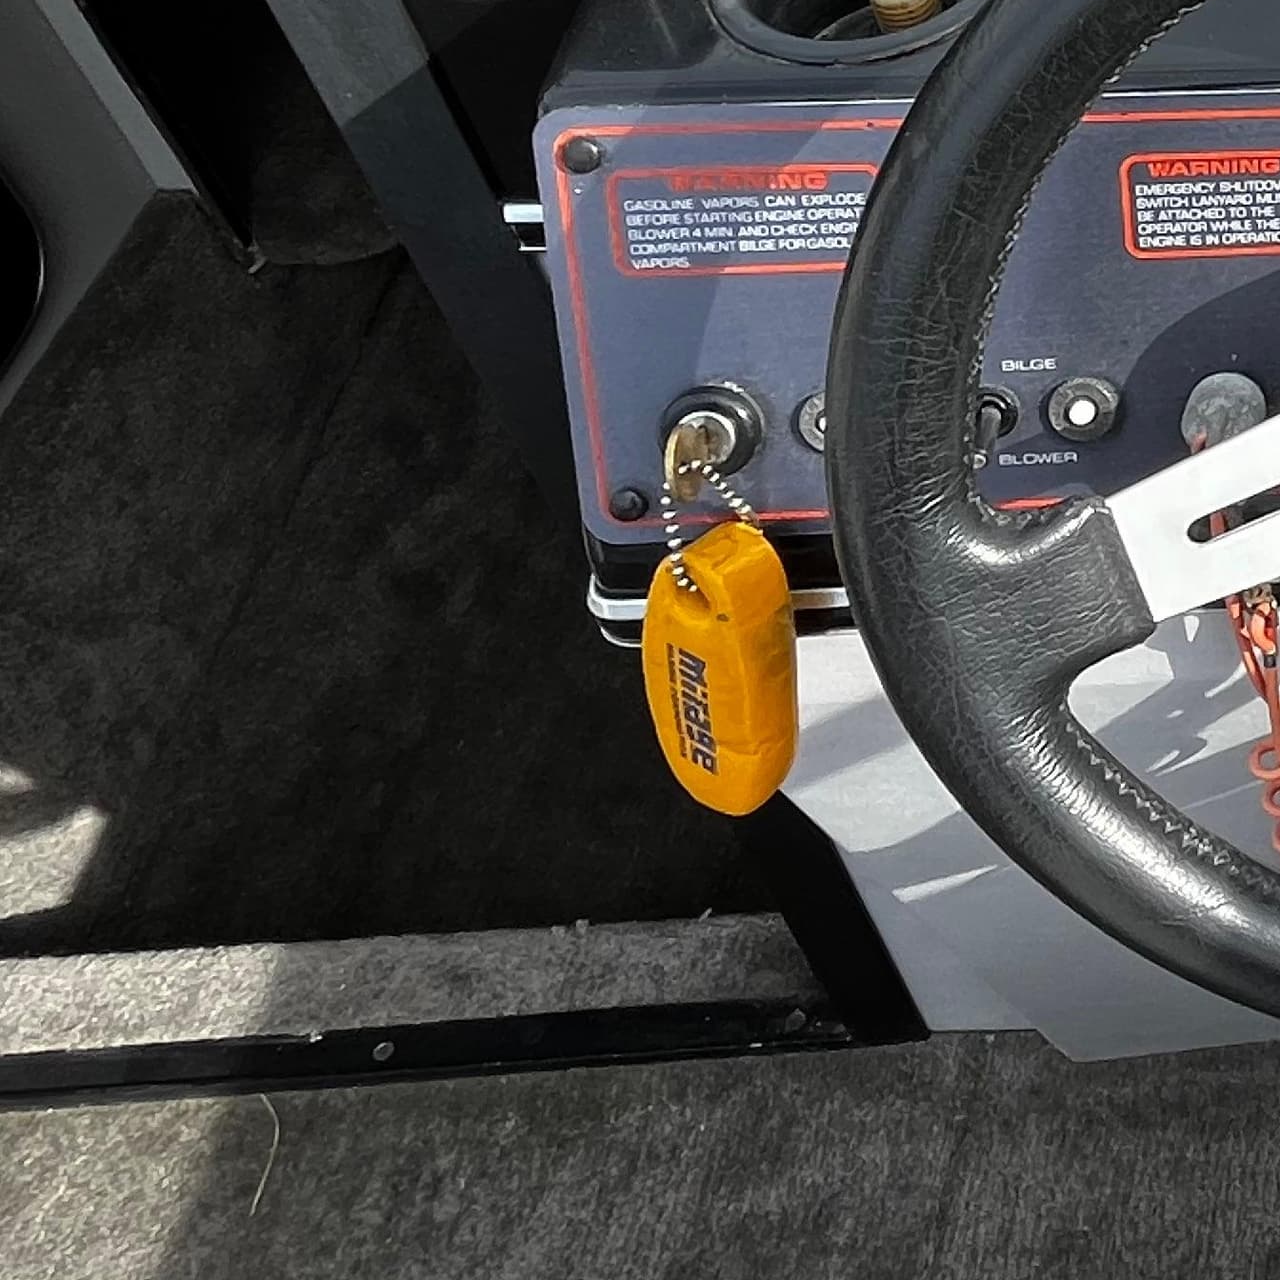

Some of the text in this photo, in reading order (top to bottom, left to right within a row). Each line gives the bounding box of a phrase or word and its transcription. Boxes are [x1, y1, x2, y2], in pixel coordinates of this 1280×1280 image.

[1135, 181, 1216, 197] EMERGENCY
[624, 193, 867, 212] GASOLINE VAPORS CAN EXPLODE
[1136, 197, 1188, 210] SWITCH
[1191, 194, 1253, 208] LANYARD
[626, 207, 863, 227] BEFORE STARTING ENGINE OPERAT
[1137, 206, 1276, 222] BE ATTACHED TO THE
[627, 227, 691, 242] BLOWER
[692, 229, 702, 239] 4
[737, 224, 769, 238] AND
[770, 222, 818, 236] CHECK
[1138, 218, 1280, 236] OPERATOR WHILE THE
[630, 240, 736, 255] COMPARTMENT
[738, 239, 777, 253] BILGE
[778, 238, 807, 251] FOR
[1139, 234, 1187, 249] ENGINE
[1189, 234, 1202, 246] IS
[1205, 233, 1219, 246] IN
[1001, 358, 1057, 372] BILGE
[999, 451, 1078, 466] BLOWER
